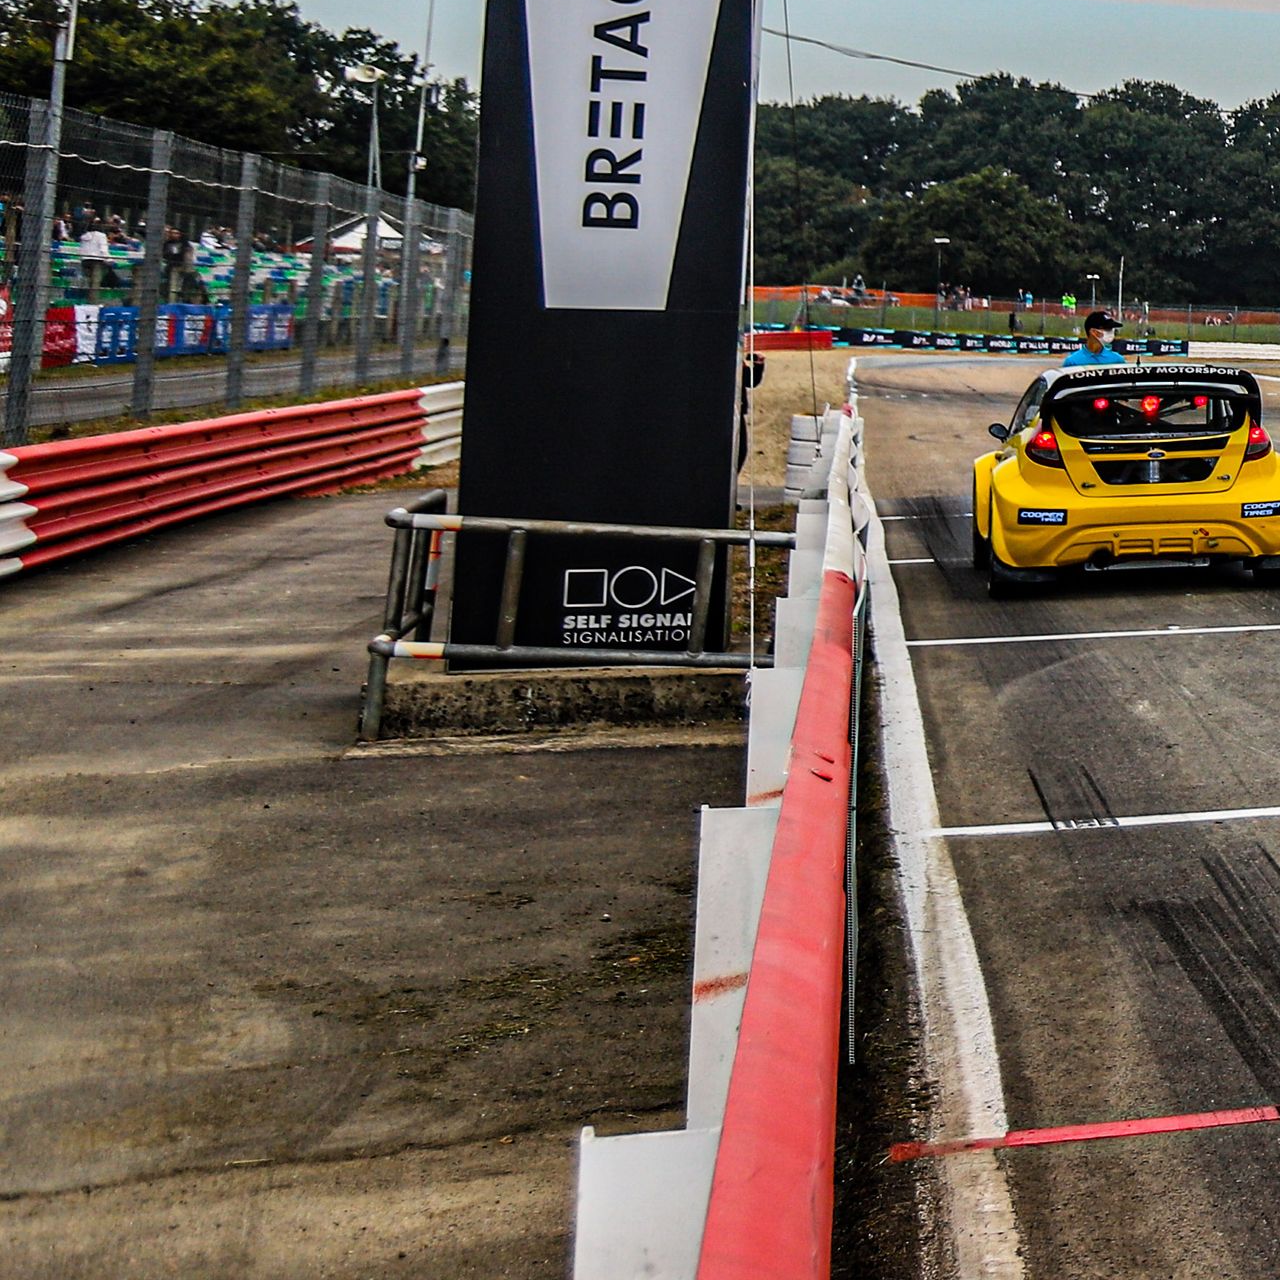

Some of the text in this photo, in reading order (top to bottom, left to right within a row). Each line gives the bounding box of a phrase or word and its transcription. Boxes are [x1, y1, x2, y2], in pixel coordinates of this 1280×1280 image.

[1069, 366, 1241, 380] TONY BARDY MOTORSPORT
[1020, 511, 1064, 519] COOPER
[563, 615, 612, 629] SELF
